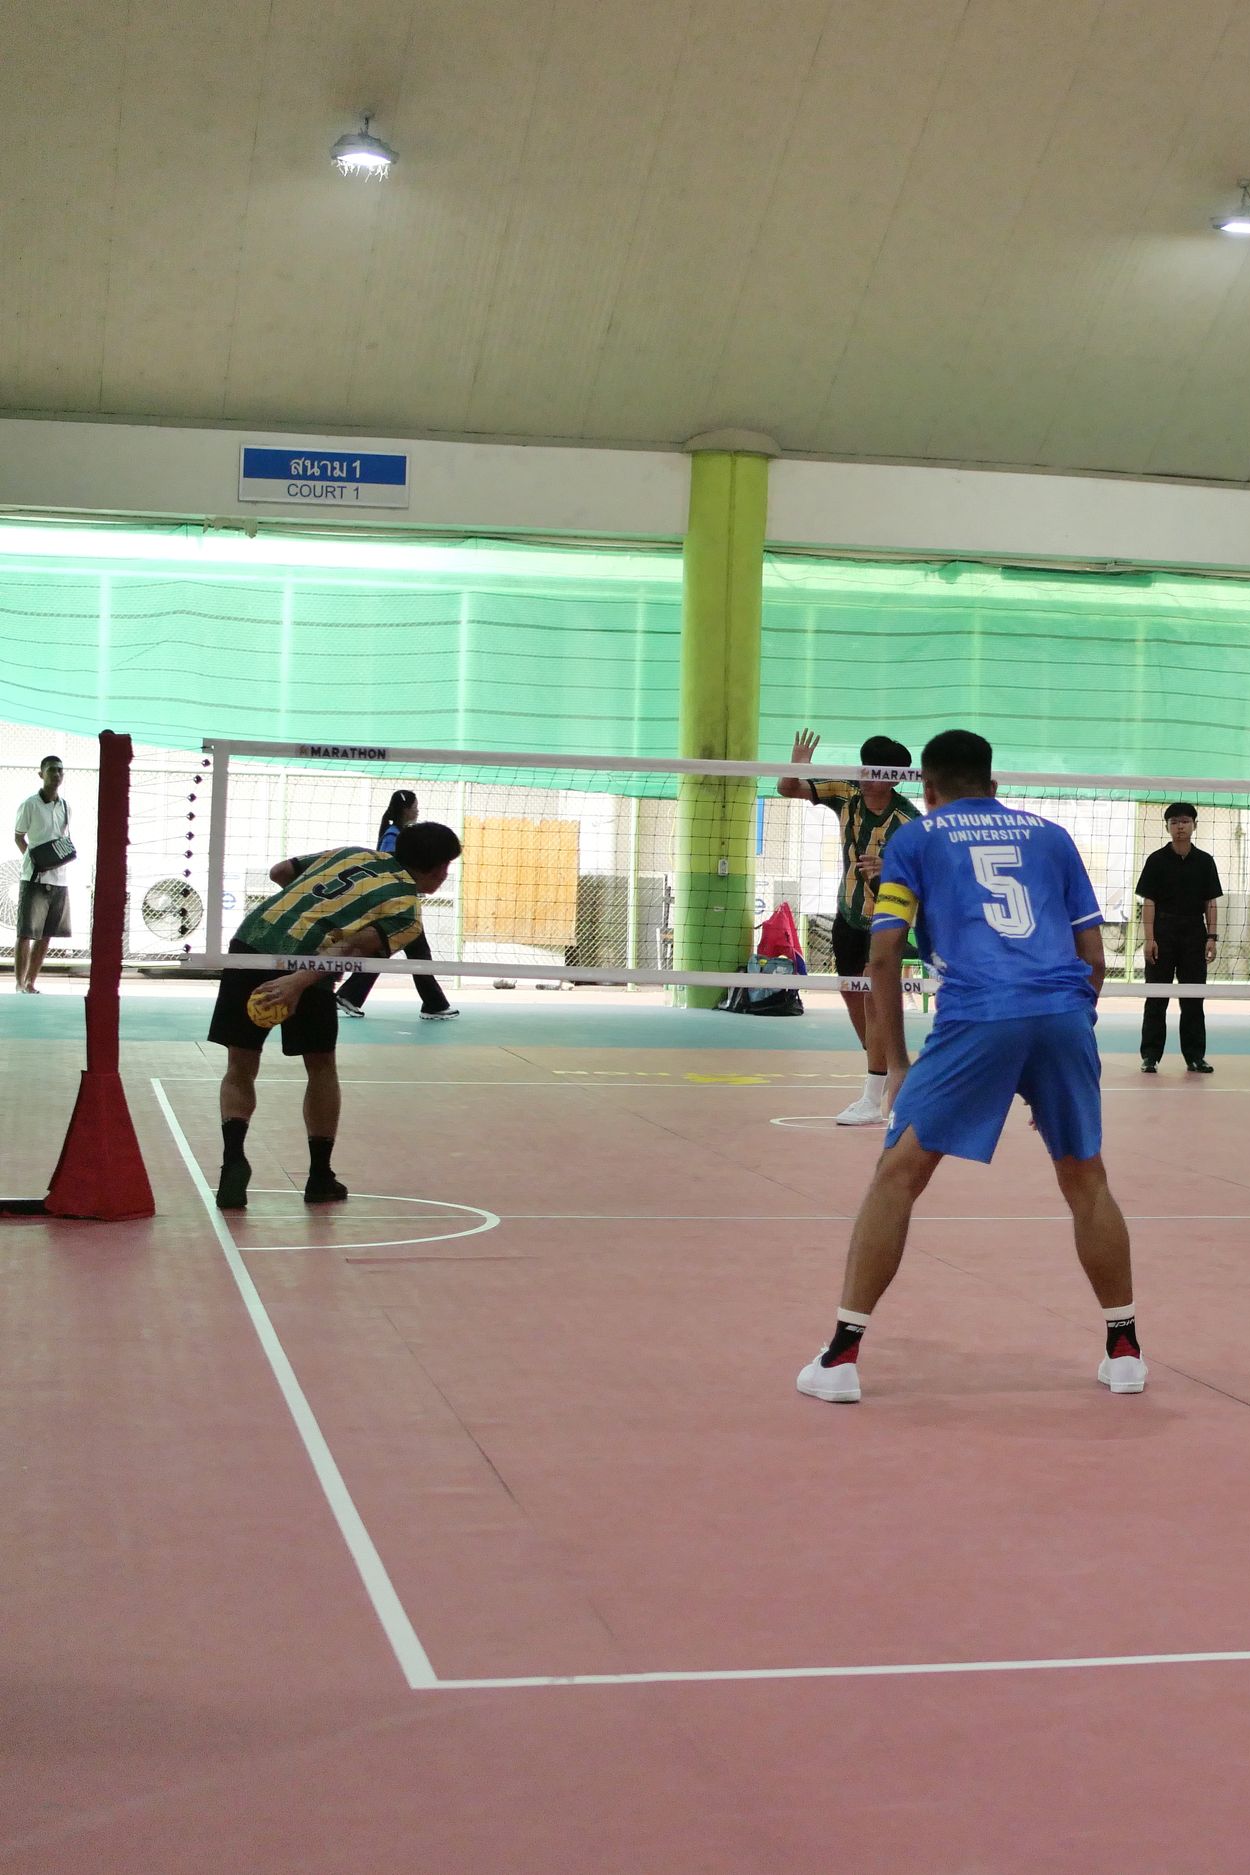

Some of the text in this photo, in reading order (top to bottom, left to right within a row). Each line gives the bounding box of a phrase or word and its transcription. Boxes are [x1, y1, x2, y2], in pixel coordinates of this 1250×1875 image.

[290, 457, 361, 479] สนาม 1
[287, 483, 360, 500] COURT 1
[311, 746, 386, 759] MARATHON
[871, 769, 923, 780] MARATH
[921, 813, 1045, 833] PATHUMTHANI
[948, 829, 1031, 843] UNIVERSITY
[312, 864, 379, 900] 5
[969, 845, 1036, 939] 5
[287, 959, 363, 972] MARATHON
